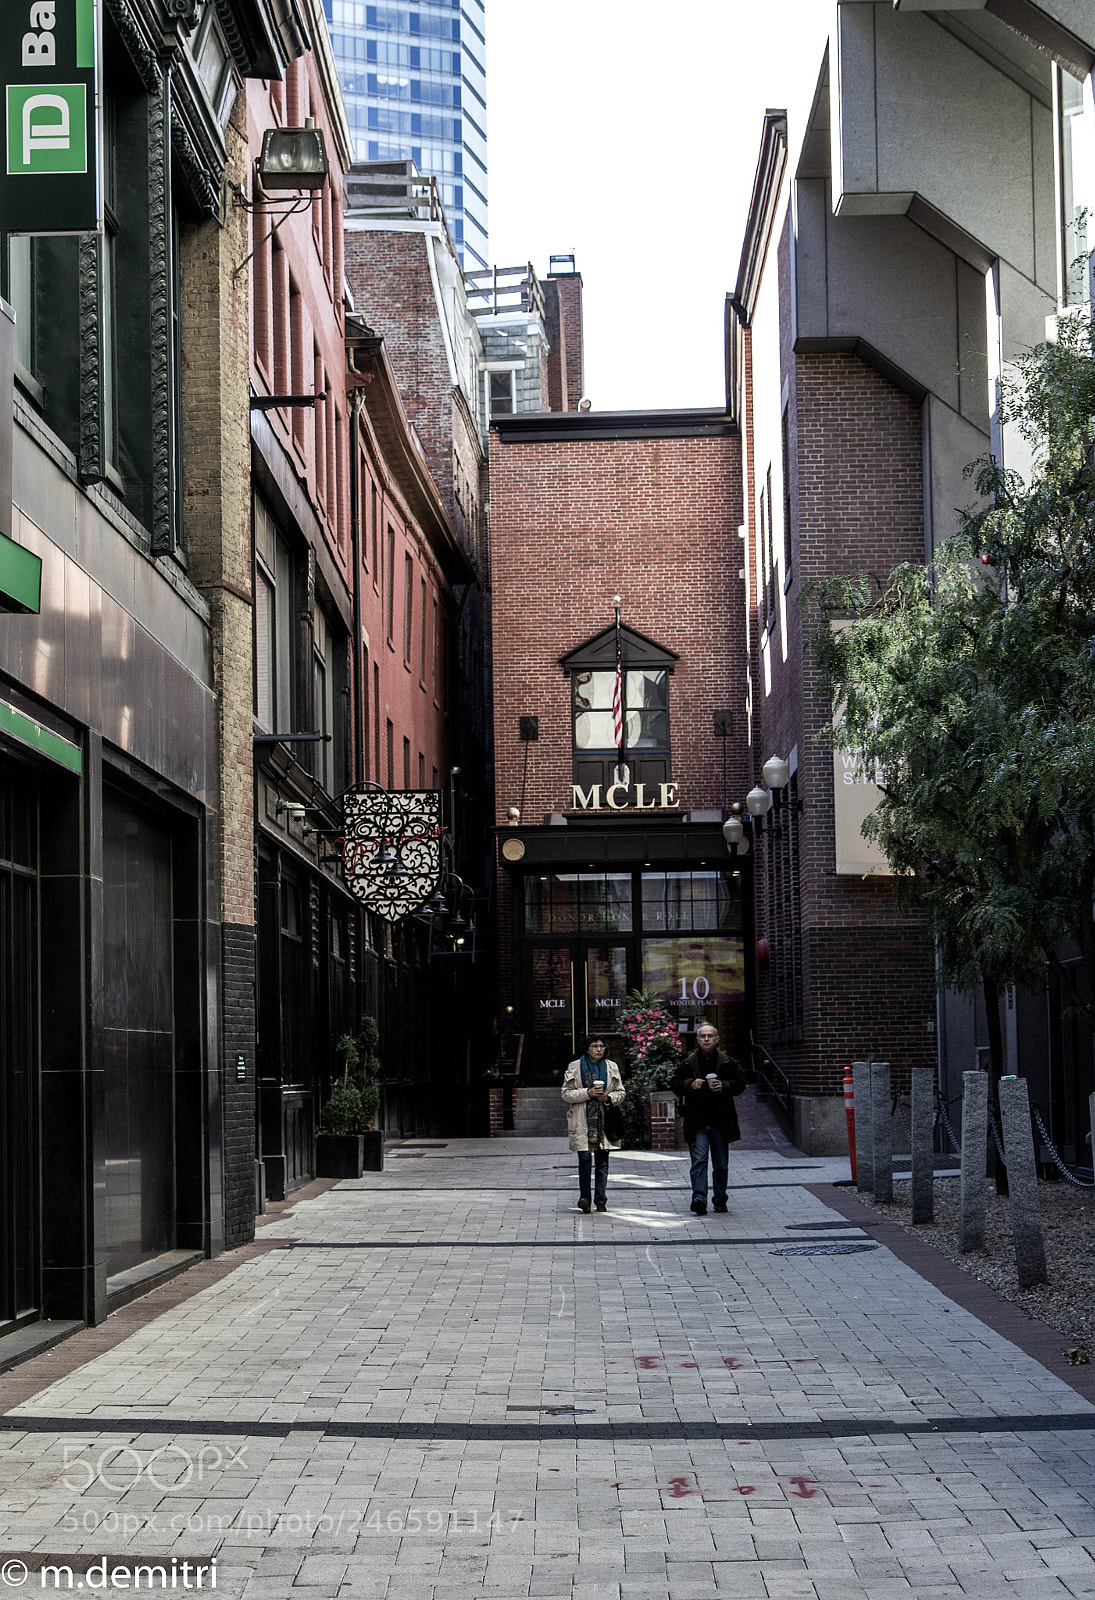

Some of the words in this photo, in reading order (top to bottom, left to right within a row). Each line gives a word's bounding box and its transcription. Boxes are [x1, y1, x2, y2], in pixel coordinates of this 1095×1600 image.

[21, 0, 56, 66] Ba
[22, 93, 71, 165] TD
[570, 782, 681, 811] MCLE
[602, 911, 649, 921] HONR
[677, 976, 710, 1000] 10
[539, 999, 566, 1008] MCLE
[595, 998, 622, 1007] MCLE
